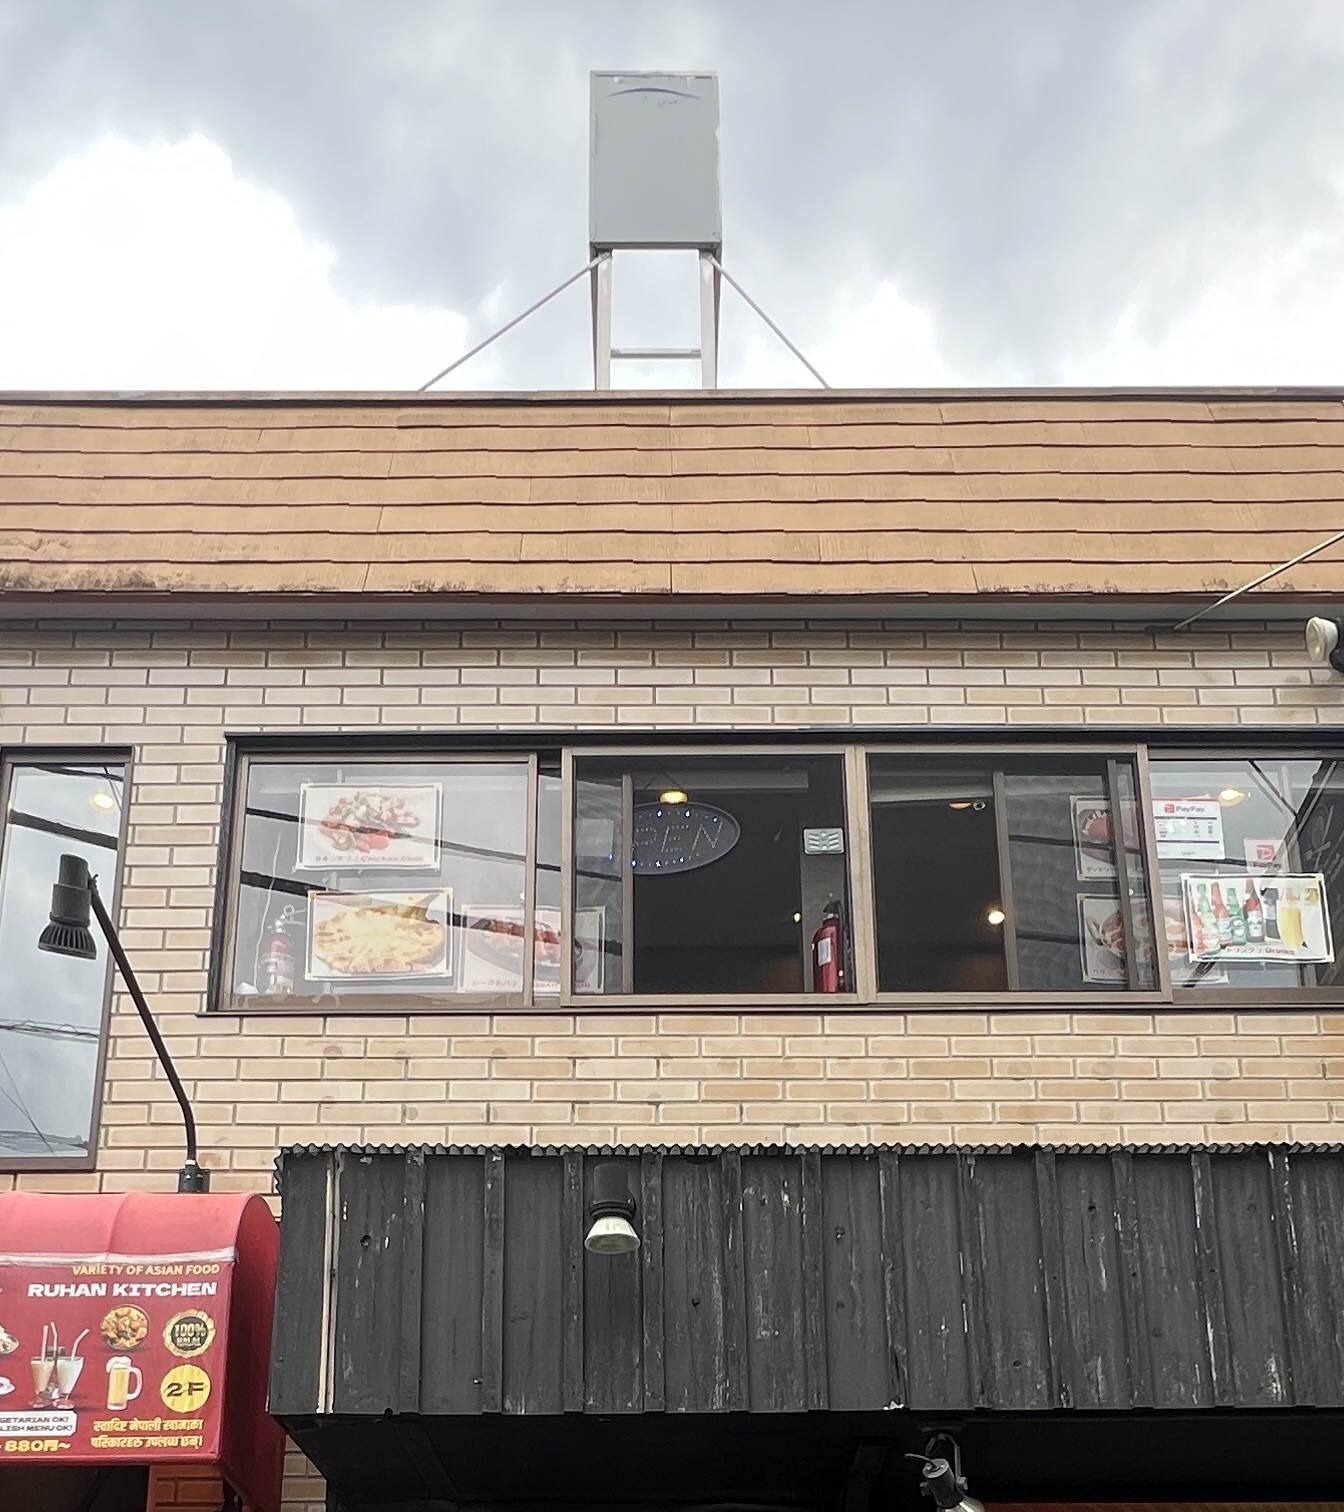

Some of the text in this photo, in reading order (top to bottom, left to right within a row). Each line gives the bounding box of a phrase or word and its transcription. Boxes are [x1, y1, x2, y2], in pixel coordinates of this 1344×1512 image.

[632, 822, 723, 853] PEN
[72, 1263, 220, 1275] VARIETY OF ASIAN FOOD
[28, 1281, 217, 1297] RUHAN KITCHEN
[167, 1381, 204, 1397] 2F
